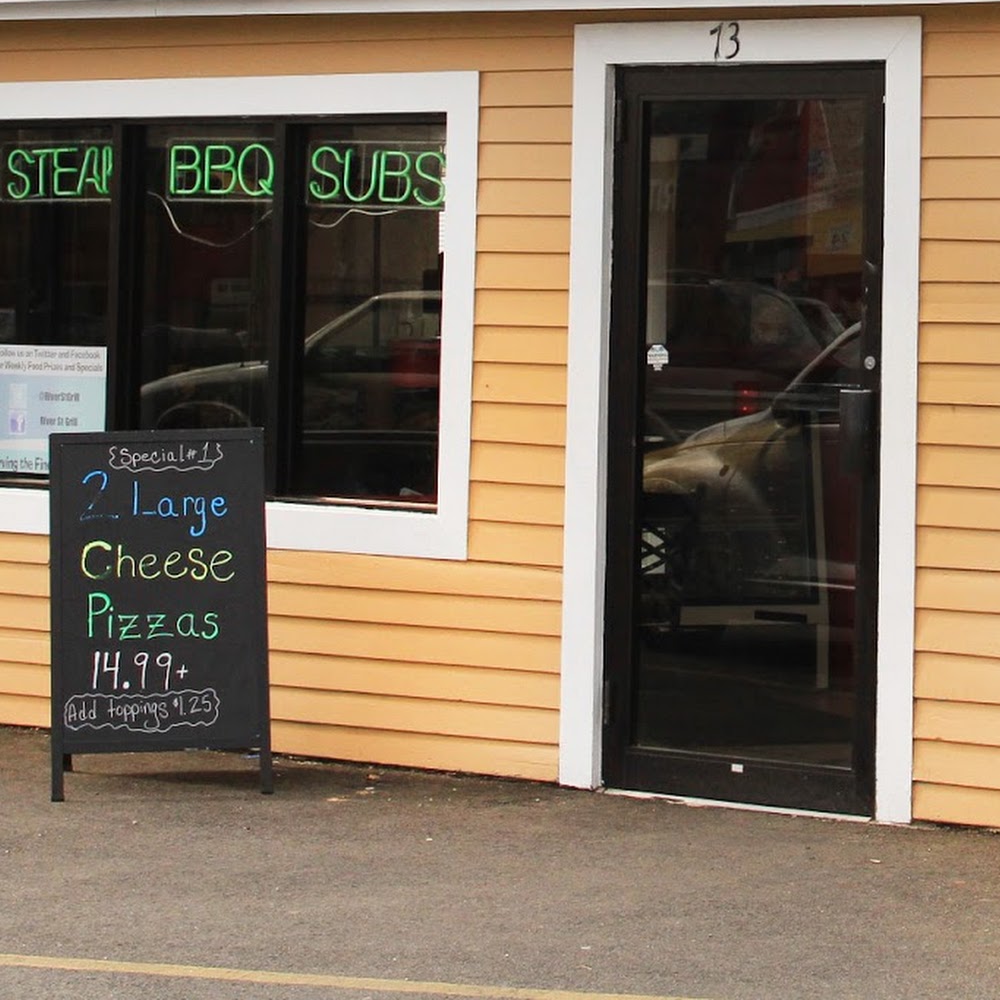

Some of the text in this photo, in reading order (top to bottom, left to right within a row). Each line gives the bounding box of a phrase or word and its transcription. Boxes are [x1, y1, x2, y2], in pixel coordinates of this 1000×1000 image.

[169, 143, 274, 196] BBQ
[309, 146, 446, 206] SUBS
[34, 457, 49, 471] Fin
[120, 444, 185, 469] Special
[80, 470, 228, 537] 2 Large
[81, 540, 235, 582] Cheese
[88, 592, 220, 640] Pizzas
[68, 695, 212, 729] Add toppings $1.25
